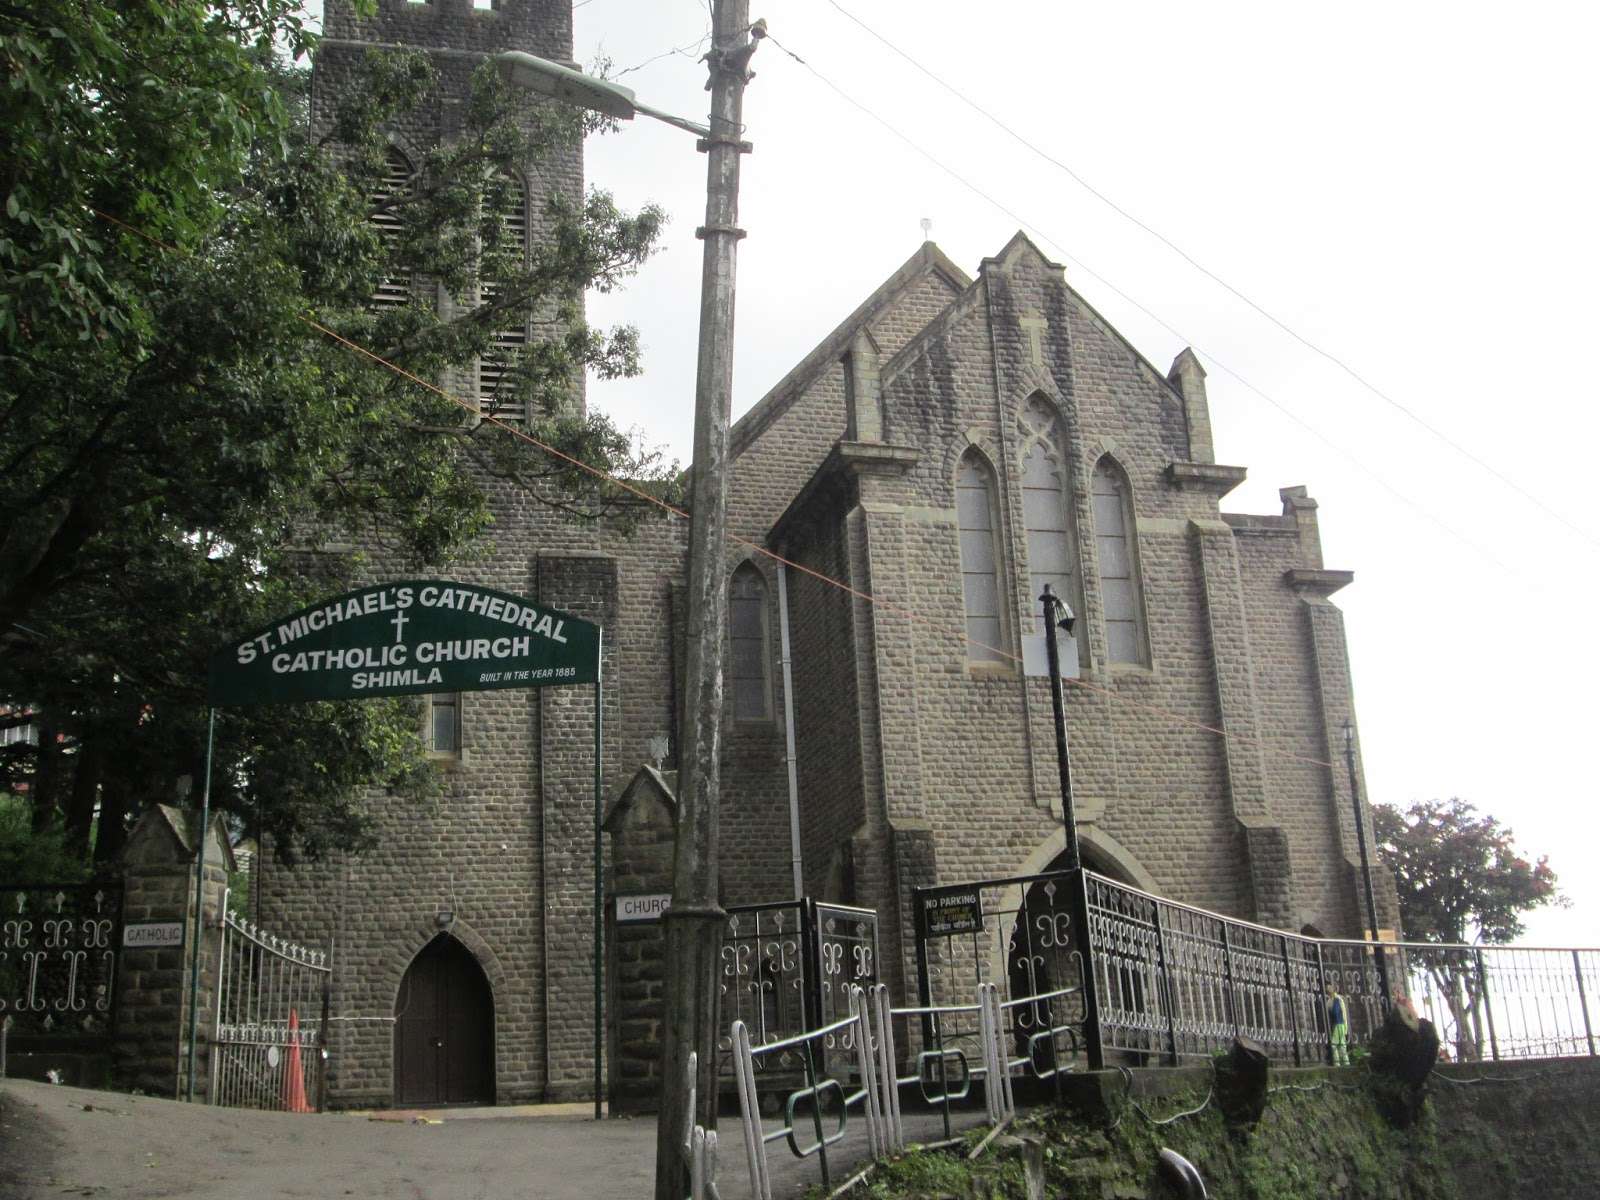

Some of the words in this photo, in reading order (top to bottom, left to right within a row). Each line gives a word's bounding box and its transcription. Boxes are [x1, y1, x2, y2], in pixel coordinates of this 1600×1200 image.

[237, 632, 276, 664] ST.
[278, 587, 414, 645] MICHAEL'S
[419, 587, 568, 644] CATHEDRAL
[272, 644, 407, 674] CATHOLIC
[415, 636, 530, 664] CHURCH
[352, 667, 443, 689] SHIMLA
[480, 672, 502, 683] BUILT
[503, 671, 512, 681] IN
[514, 670, 530, 680] THE
[531, 669, 554, 679] YEAR
[555, 667, 576, 677] 1885
[624, 898, 670, 914] CHURC
[926, 899, 938, 909] NO
[940, 895, 976, 908] PARKING
[127, 927, 180, 942] CATHOLIC
